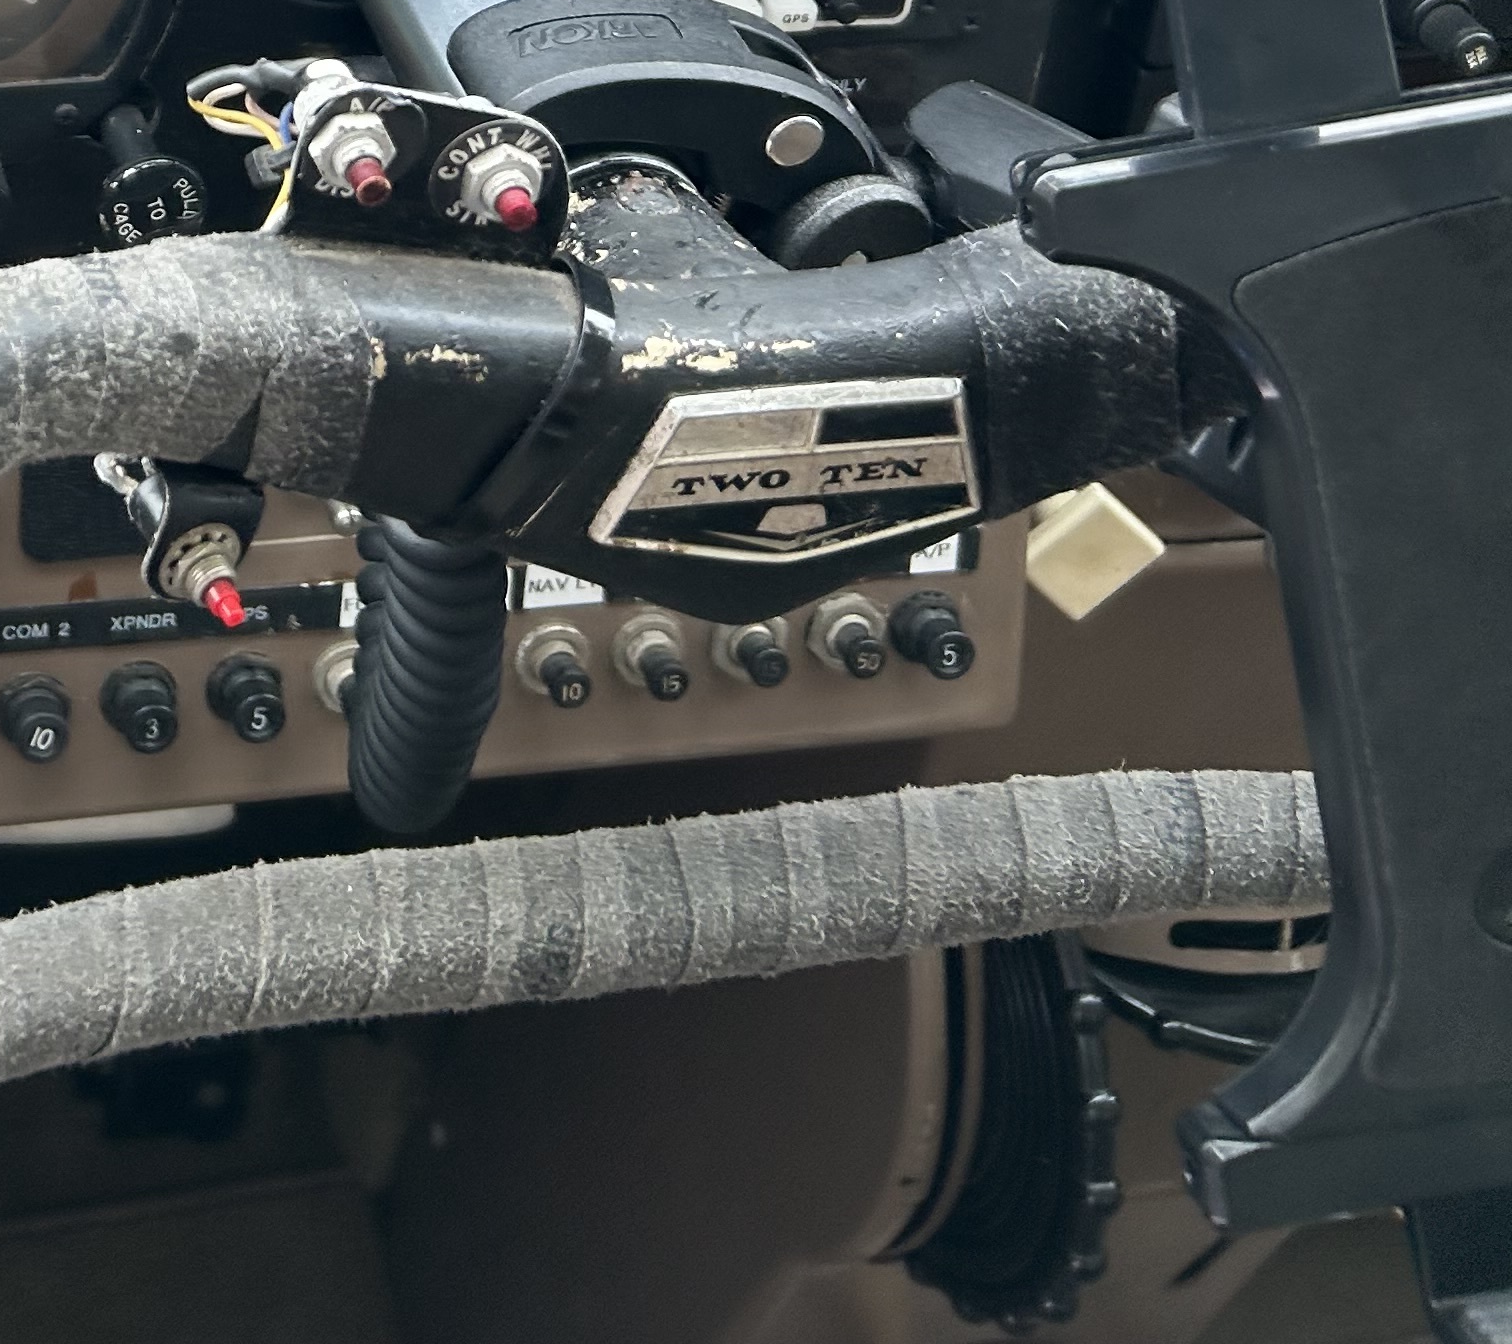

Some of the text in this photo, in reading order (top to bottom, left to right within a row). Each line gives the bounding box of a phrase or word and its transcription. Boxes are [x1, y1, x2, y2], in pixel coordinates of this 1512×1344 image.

[782, 14, 809, 23] GPS
[147, 197, 166, 220] TO
[113, 203, 143, 243] CAGE
[673, 457, 929, 496] TWO TEN
[528, 578, 566, 594] NAV
[110, 612, 178, 632] XPNDR
[245, 605, 269, 621] PS
[2, 621, 71, 641] COM 2
[857, 652, 882, 670] 50
[942, 643, 957, 666] 5
[561, 683, 583, 701] 10
[663, 674, 681, 693] 15
[251, 707, 268, 730] 5
[30, 726, 54, 751] 10
[145, 718, 159, 740] 3
